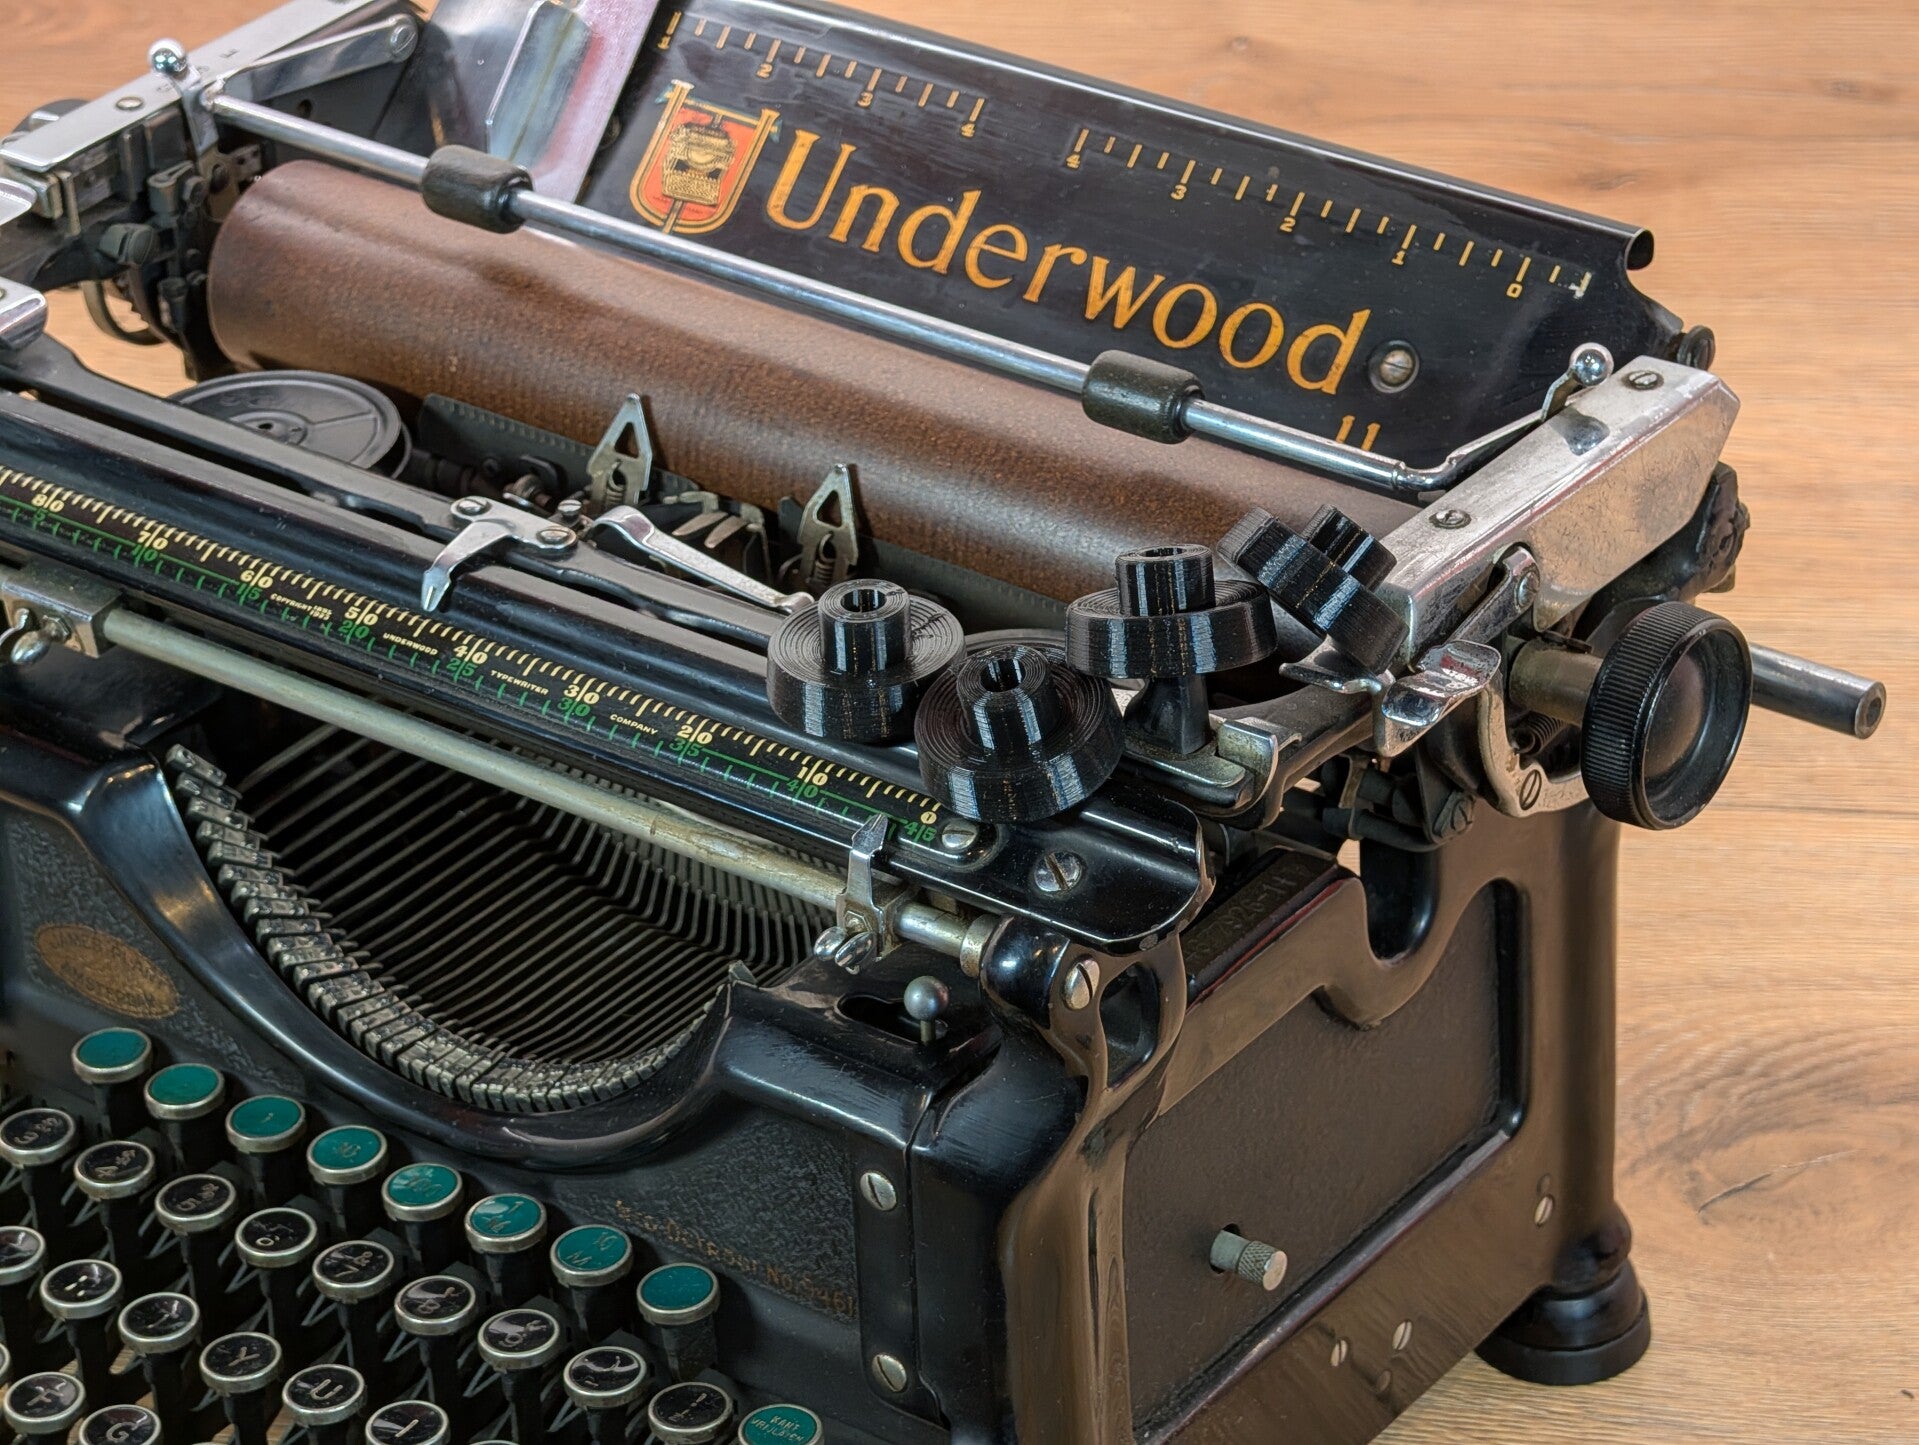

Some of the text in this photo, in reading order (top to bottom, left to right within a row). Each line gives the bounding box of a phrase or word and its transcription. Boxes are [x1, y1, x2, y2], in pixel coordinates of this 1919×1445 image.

[756, 62, 772, 78] 2
[857, 92, 874, 107] 3
[960, 122, 976, 137] 4
[1066, 153, 1523, 298] 4 3 2 1 0
[766, 130, 1371, 394] Underwood
[270, 593, 312, 612] COPYRIGHT
[31, 494, 65, 513] 80
[137, 532, 168, 550] 70
[240, 570, 274, 588] 60
[344, 607, 379, 625] 50
[453, 645, 488, 665] 40
[563, 684, 600, 704] 30
[676, 725, 713, 745] 20
[797, 766, 828, 786] 10
[921, 811, 937, 824] 0
[382, 632, 659, 735] UNDERWOOD TYPEWRITER COMPANY
[447, 658, 478, 676] 25
[557, 697, 591, 717] 30
[669, 737, 701, 758] 35
[786, 779, 817, 798] 40
[418, 1300, 441, 1315] 8
[499, 1333, 523, 1347] 9
[228, 1346, 260, 1366] Y
[310, 1379, 343, 1400] U
[106, 1422, 136, 1442] G
[395, 1419, 419, 1438] I
